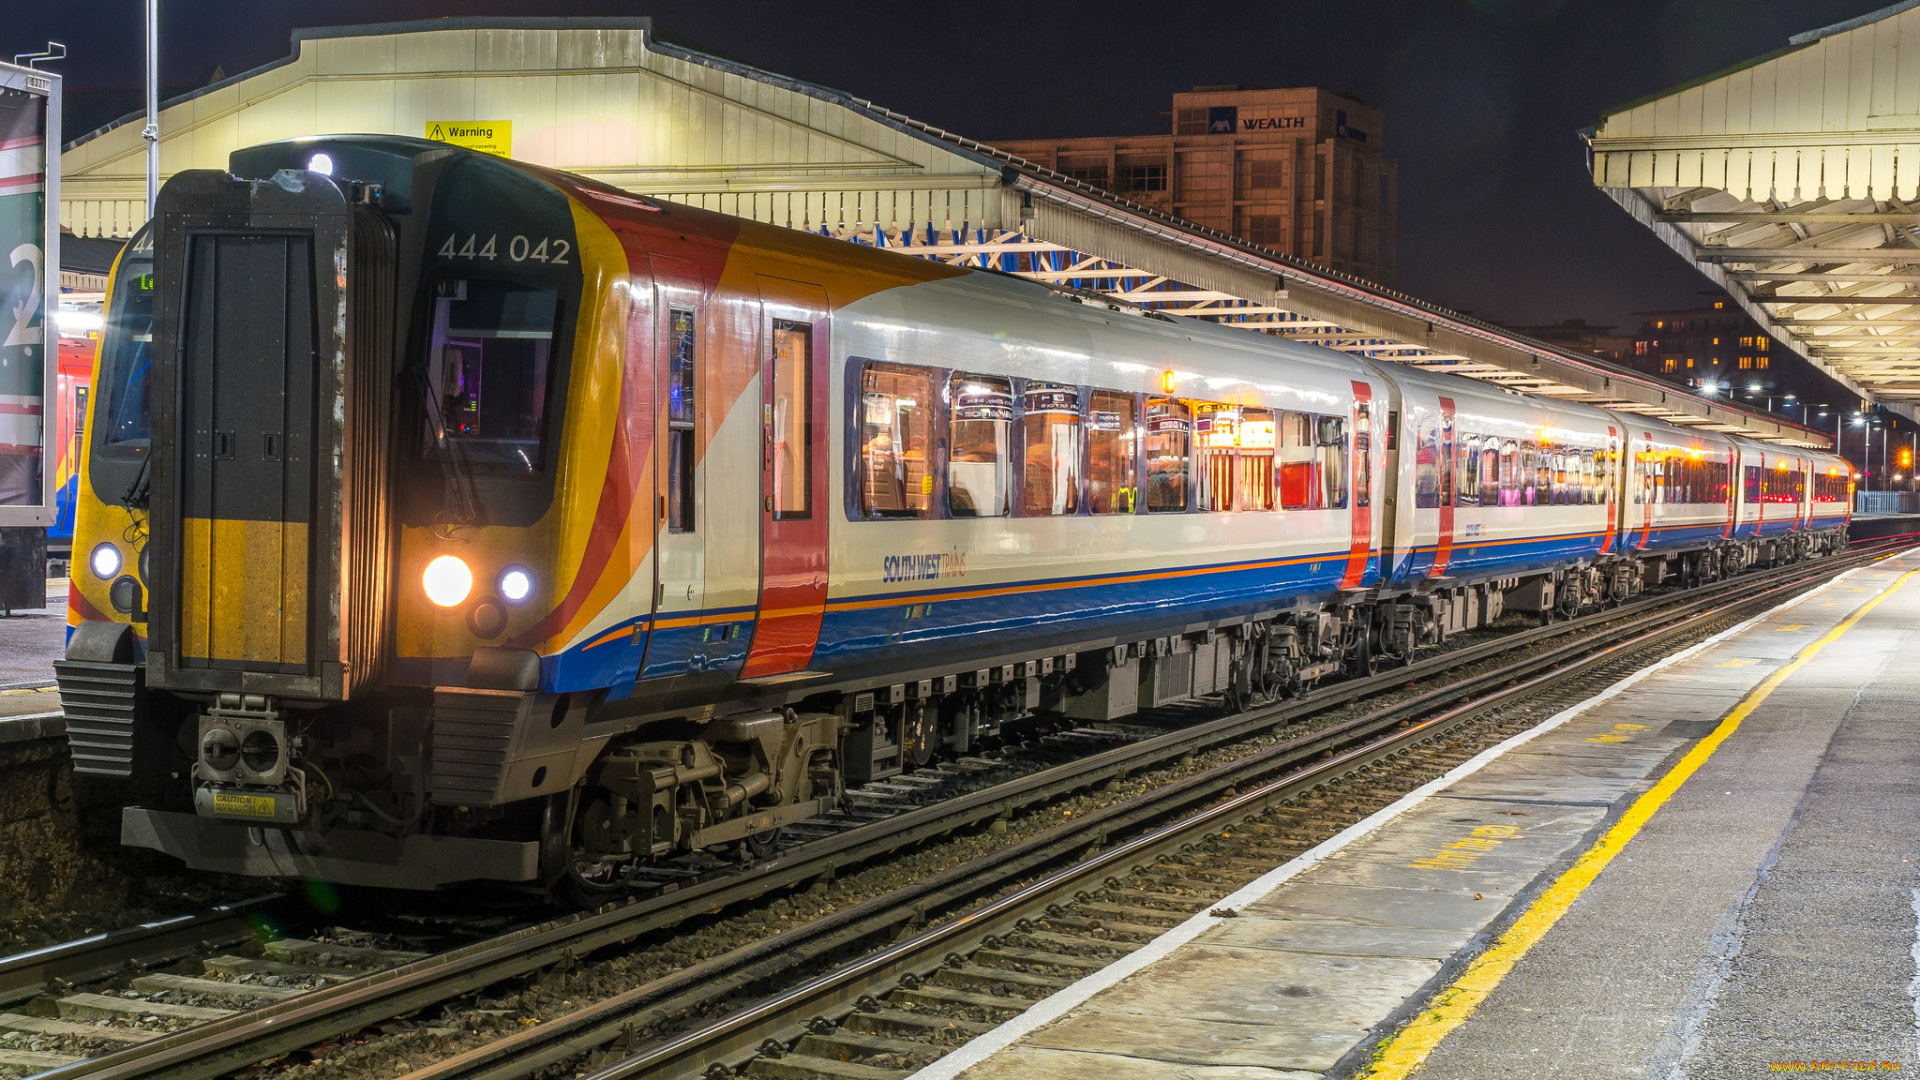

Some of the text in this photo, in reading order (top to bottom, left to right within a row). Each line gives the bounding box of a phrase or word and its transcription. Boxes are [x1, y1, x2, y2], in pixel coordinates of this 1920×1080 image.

[449, 127, 493, 139] Warning
[1209, 117, 1304, 131] AXA WEALTH
[437, 232, 570, 265] 444 042
[3, 243, 44, 347] 2
[883, 545, 967, 583] SOUTH WEST TRAINS
[216, 795, 251, 804] CAUTION
